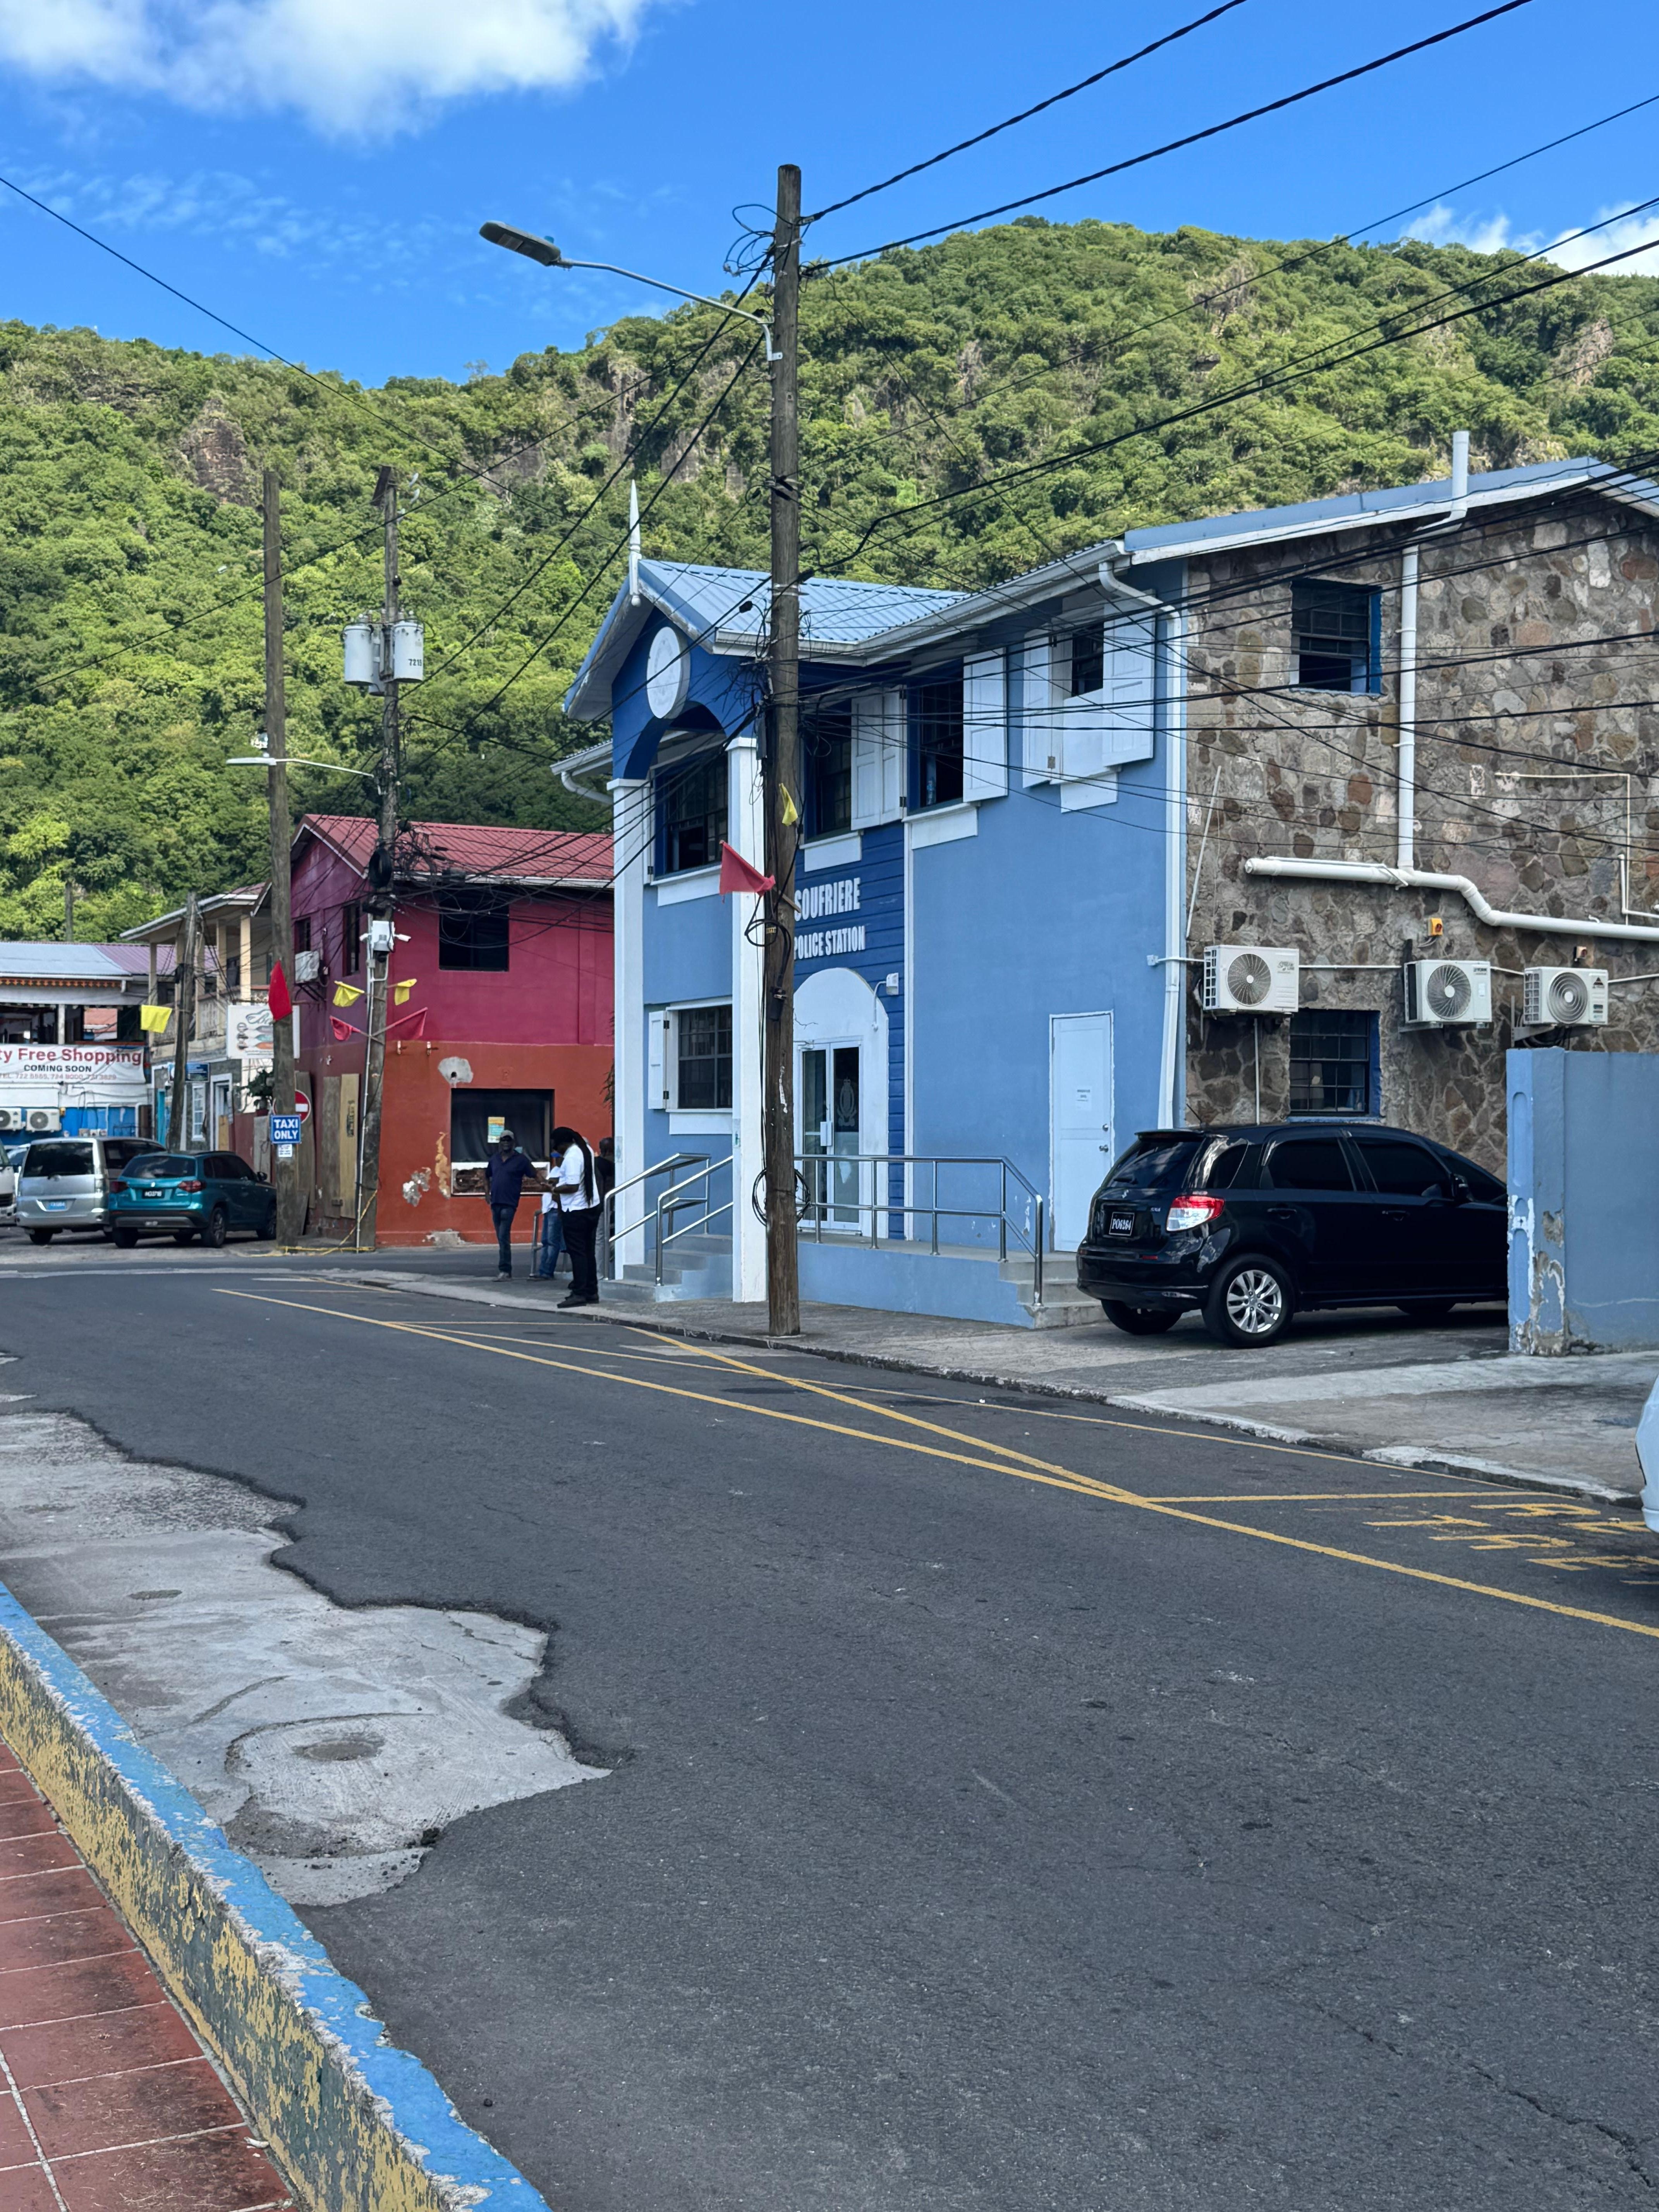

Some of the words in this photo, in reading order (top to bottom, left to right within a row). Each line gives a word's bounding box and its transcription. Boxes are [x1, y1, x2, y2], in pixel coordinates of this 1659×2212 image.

[794, 877, 860, 921] SOUFRIERE
[794, 932, 824, 960] POLICE
[825, 926, 866, 956] STATION
[18, 1048, 57, 1061] Free
[62, 1048, 141, 1065] Shopping
[274, 1119, 299, 1128] TAXI
[274, 1130, 298, 1139] ONLY
